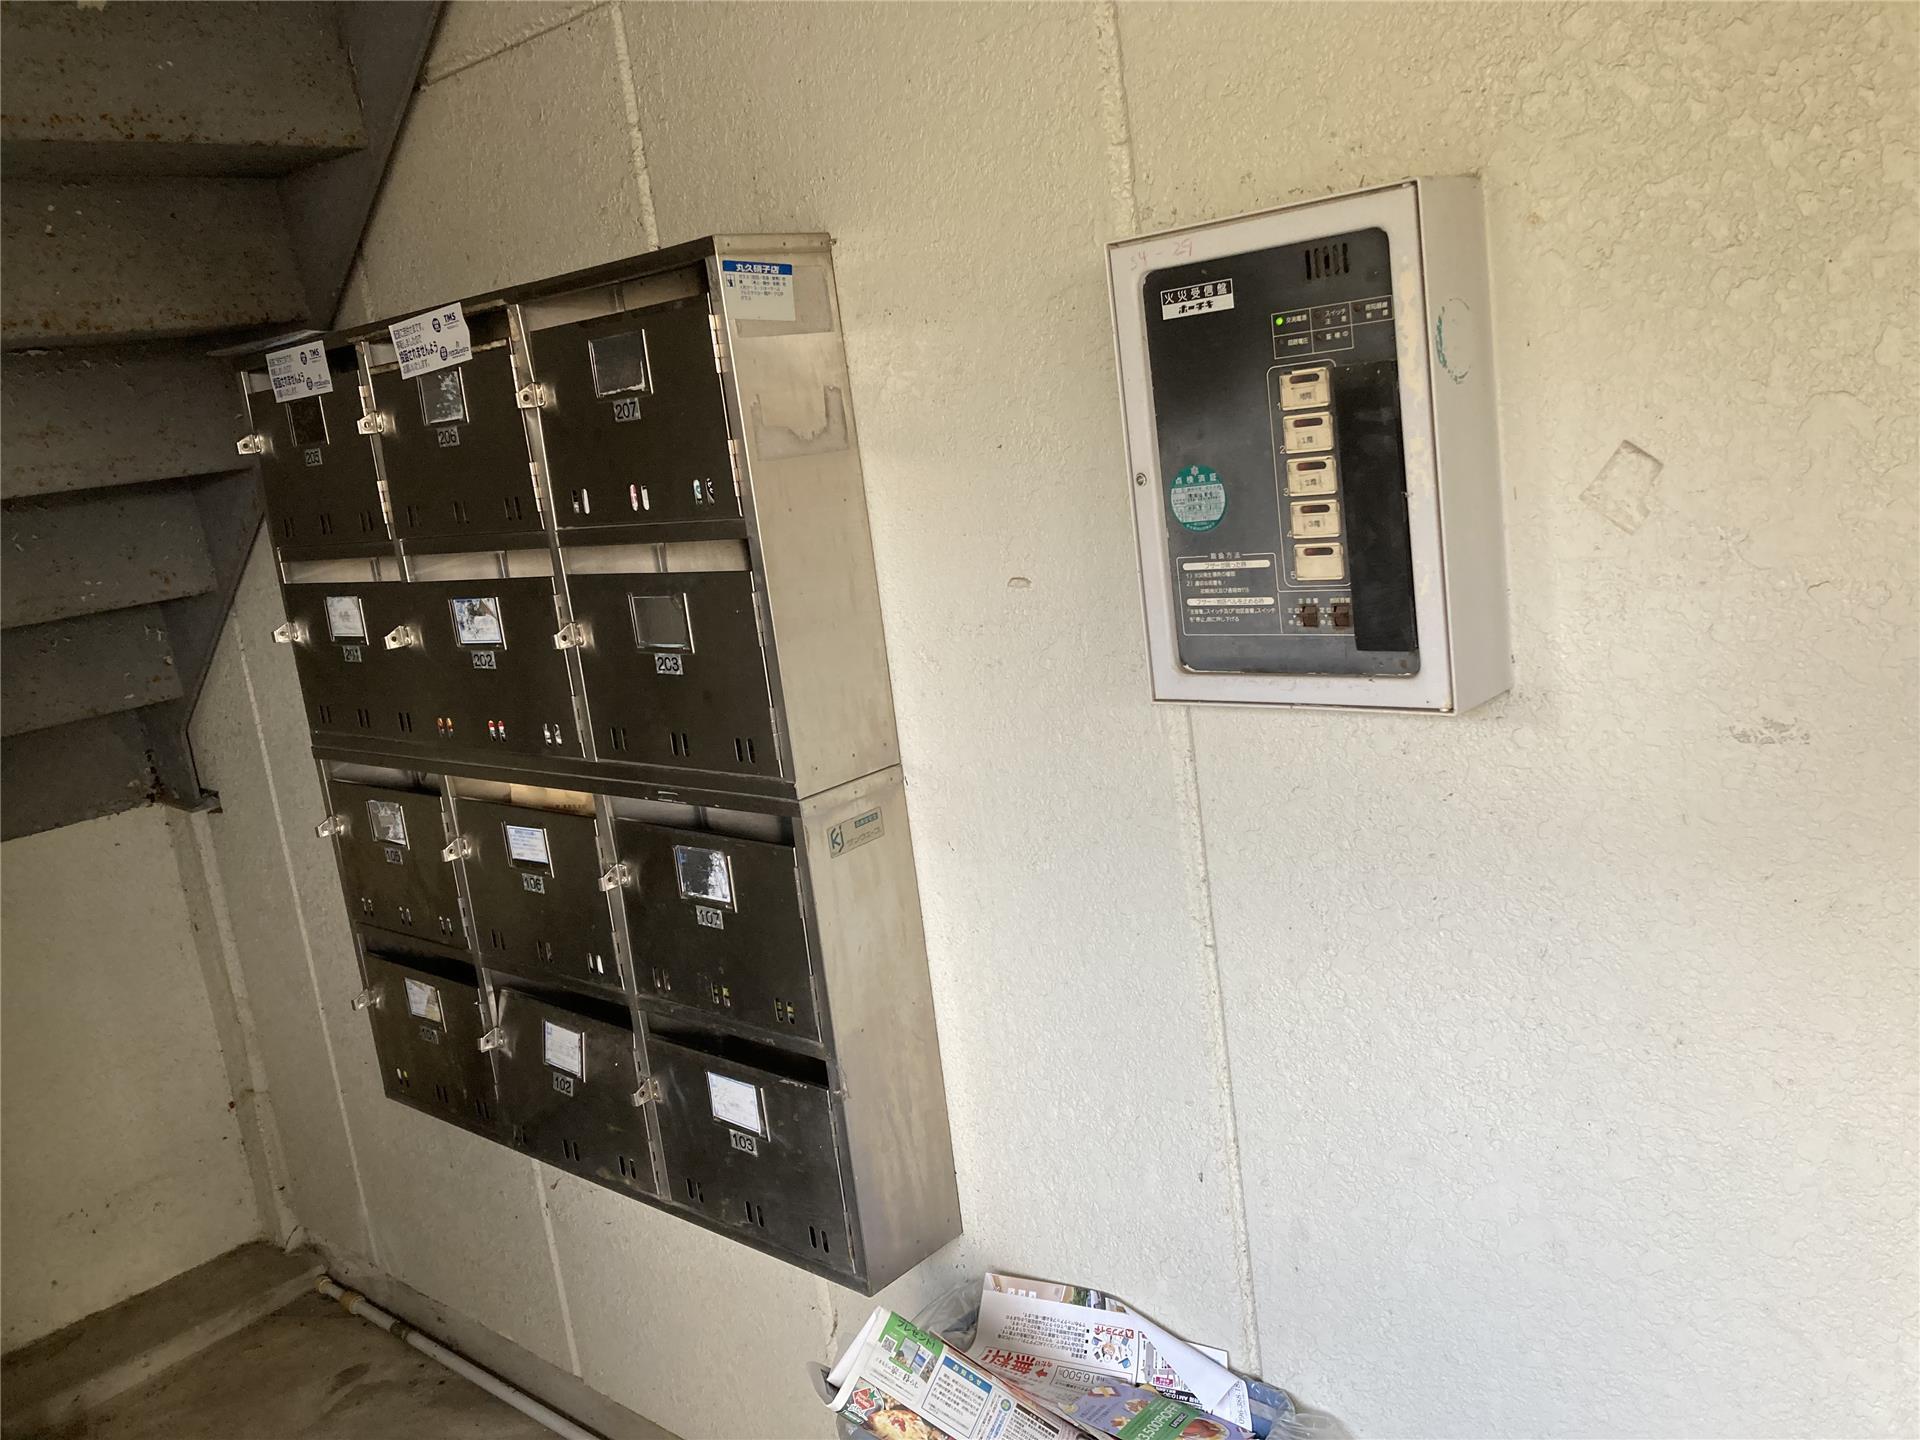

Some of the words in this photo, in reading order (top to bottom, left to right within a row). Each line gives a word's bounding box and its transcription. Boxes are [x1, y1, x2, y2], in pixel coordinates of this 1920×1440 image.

[735, 263, 780, 274] 丸久硝子店
[1163, 282, 1228, 305] 火災受信盤
[1178, 299, 1214, 314] ホーチキ
[443, 312, 457, 323] TMS
[309, 348, 320, 358] TMS
[615, 402, 637, 419] 207
[439, 428, 458, 446] 206
[1279, 445, 1287, 455] 2
[1282, 487, 1290, 497] 3
[1290, 570, 1297, 580] 5
[473, 653, 495, 668] 202
[657, 656, 680, 672] 203
[699, 908, 721, 928] 107
[555, 1075, 572, 1093] 102
[733, 1134, 755, 1152] 103
[896, 1318, 937, 1350] プレゼント!
[981, 1348, 1035, 1375] 無料!
[952, 1362, 984, 1388] お知らせ
